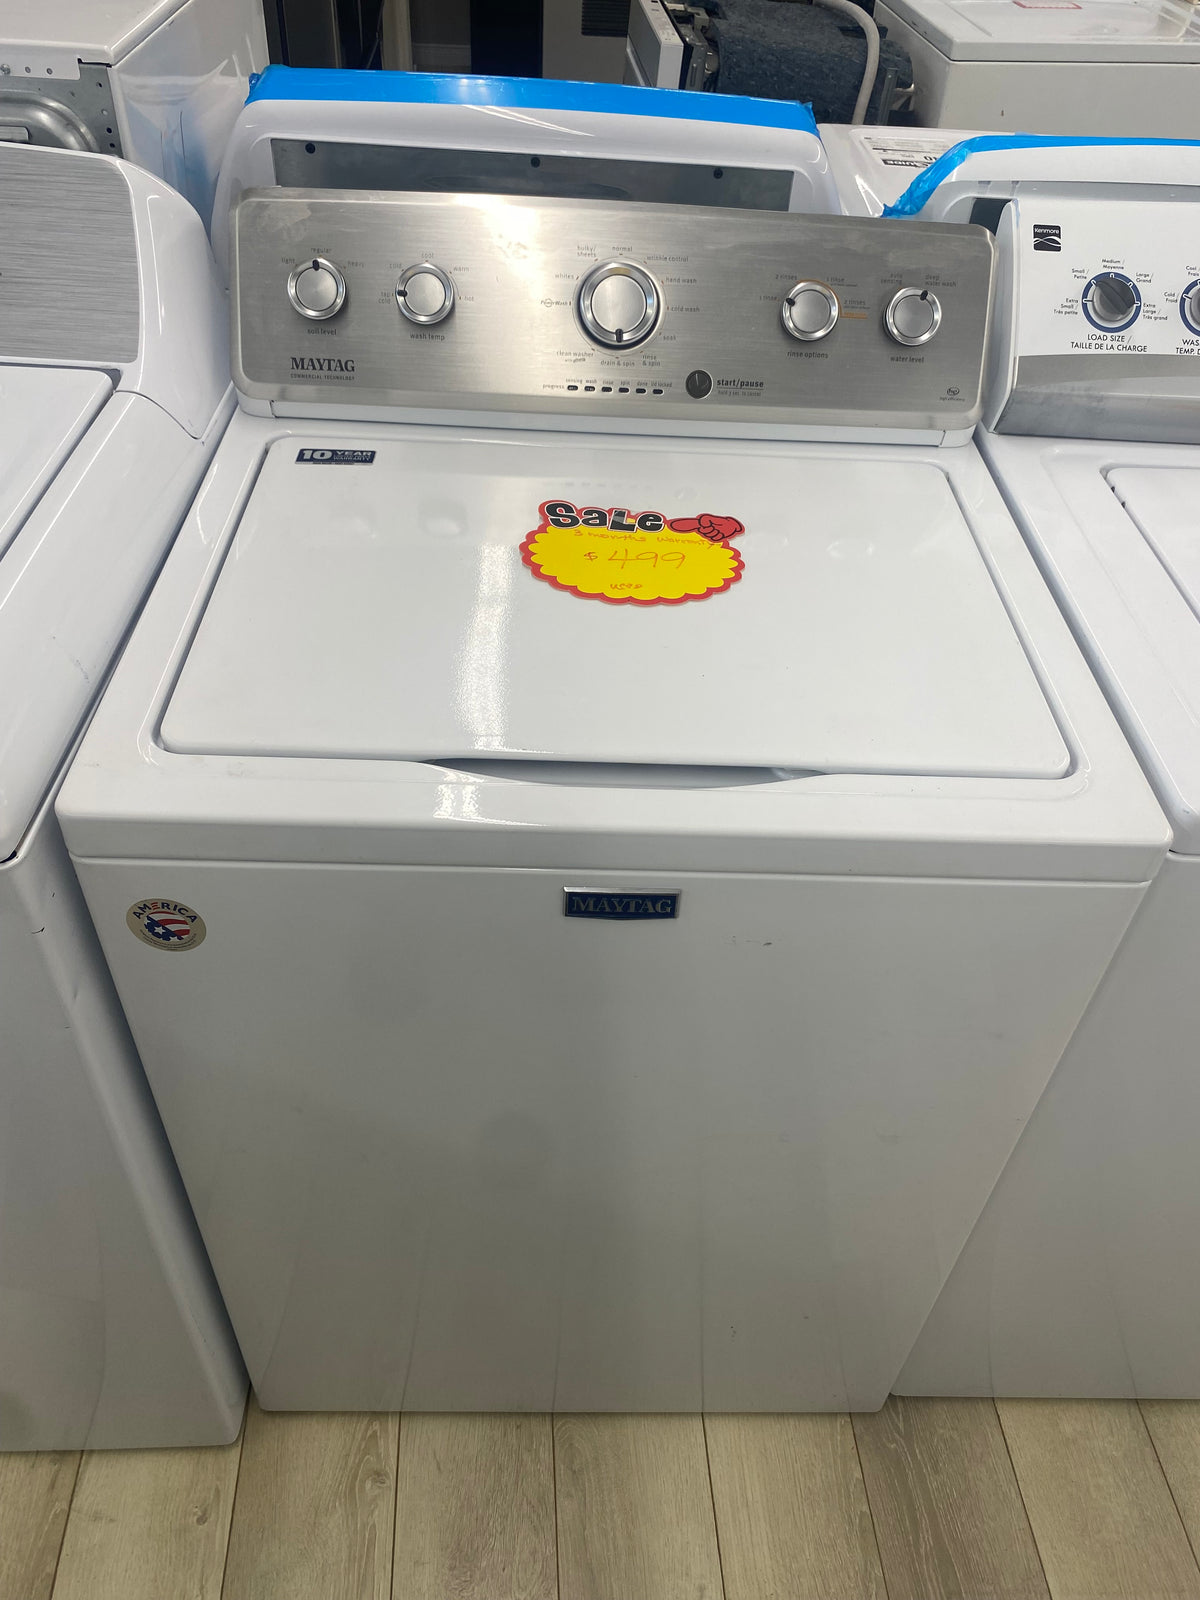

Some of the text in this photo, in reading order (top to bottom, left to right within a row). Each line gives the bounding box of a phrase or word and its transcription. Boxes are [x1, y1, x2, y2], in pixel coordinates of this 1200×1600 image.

[1034, 227, 1059, 235] Kenmore
[311, 247, 332, 255] regular
[668, 255, 689, 263] control
[665, 276, 681, 284] hand
[320, 328, 337, 336] level
[409, 332, 446, 342] wash temp
[1087, 333, 1108, 342] LOAD
[1109, 335, 1126, 343] SIZE
[1070, 341, 1148, 353] TAILLE DE LA CHARGE
[1175, 347, 1195, 355] TEMP.
[787, 350, 829, 359] rinse options
[648, 360, 661, 368] spin
[890, 355, 925, 364] water level
[290, 357, 355, 372] MAYTAG
[716, 378, 764, 389] start/pause
[302, 449, 333, 460] 10
[573, 529, 584, 537] 3
[583, 548, 686, 569] $ 499
[571, 896, 672, 913] MAYTAG
[132, 902, 198, 923] AMERICA
